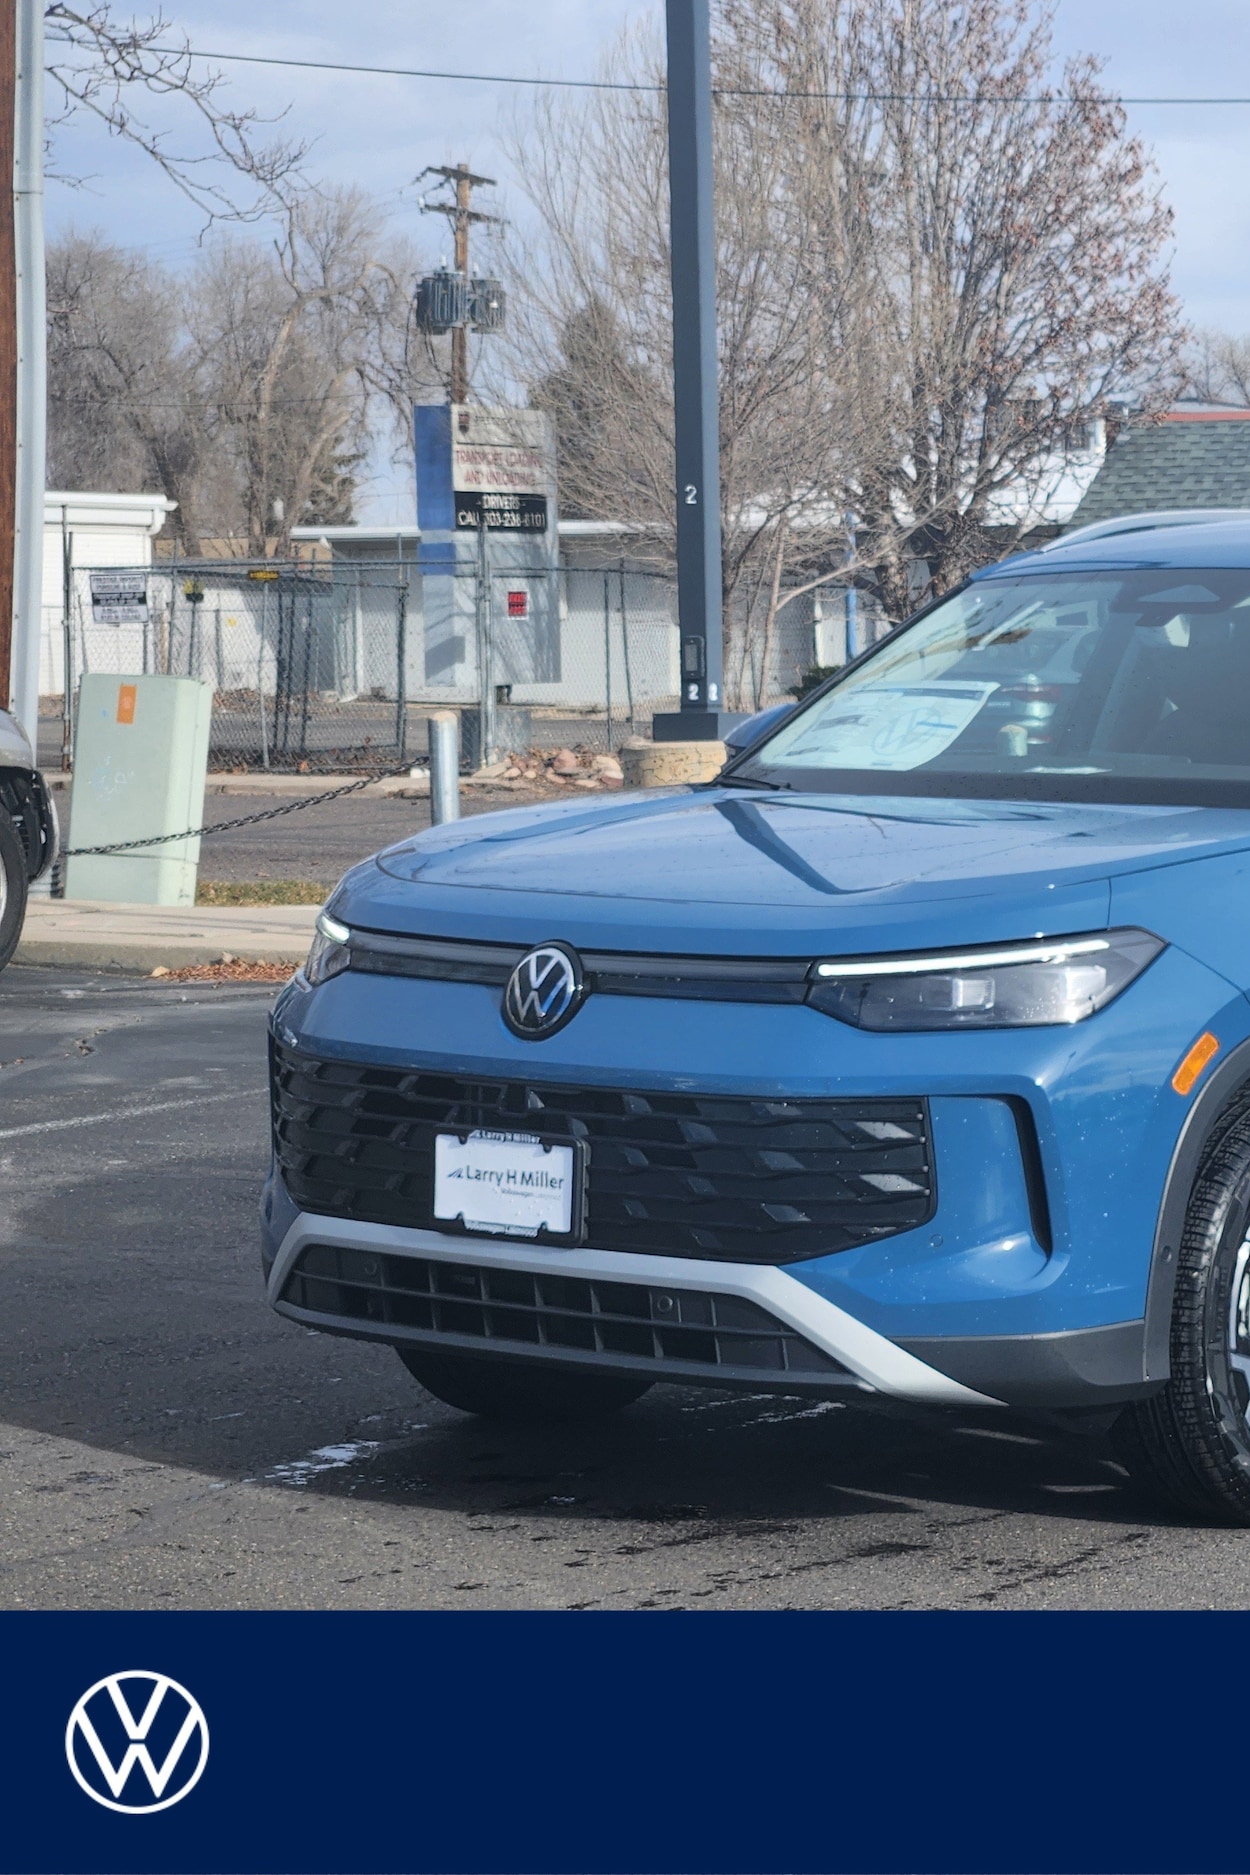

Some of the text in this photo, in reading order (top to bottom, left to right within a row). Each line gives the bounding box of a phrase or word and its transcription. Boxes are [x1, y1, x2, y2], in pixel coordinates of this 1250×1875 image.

[464, 469, 484, 485] AND
[482, 493, 520, 510] DRIVERS
[684, 484, 697, 504] 2
[458, 510, 480, 526] CALL
[688, 683, 699, 701] 2
[506, 947, 574, 1032] VW
[481, 1129, 507, 1142] Larry
[513, 1132, 541, 1144] Miller
[466, 1164, 564, 1189] Larry H Miller
